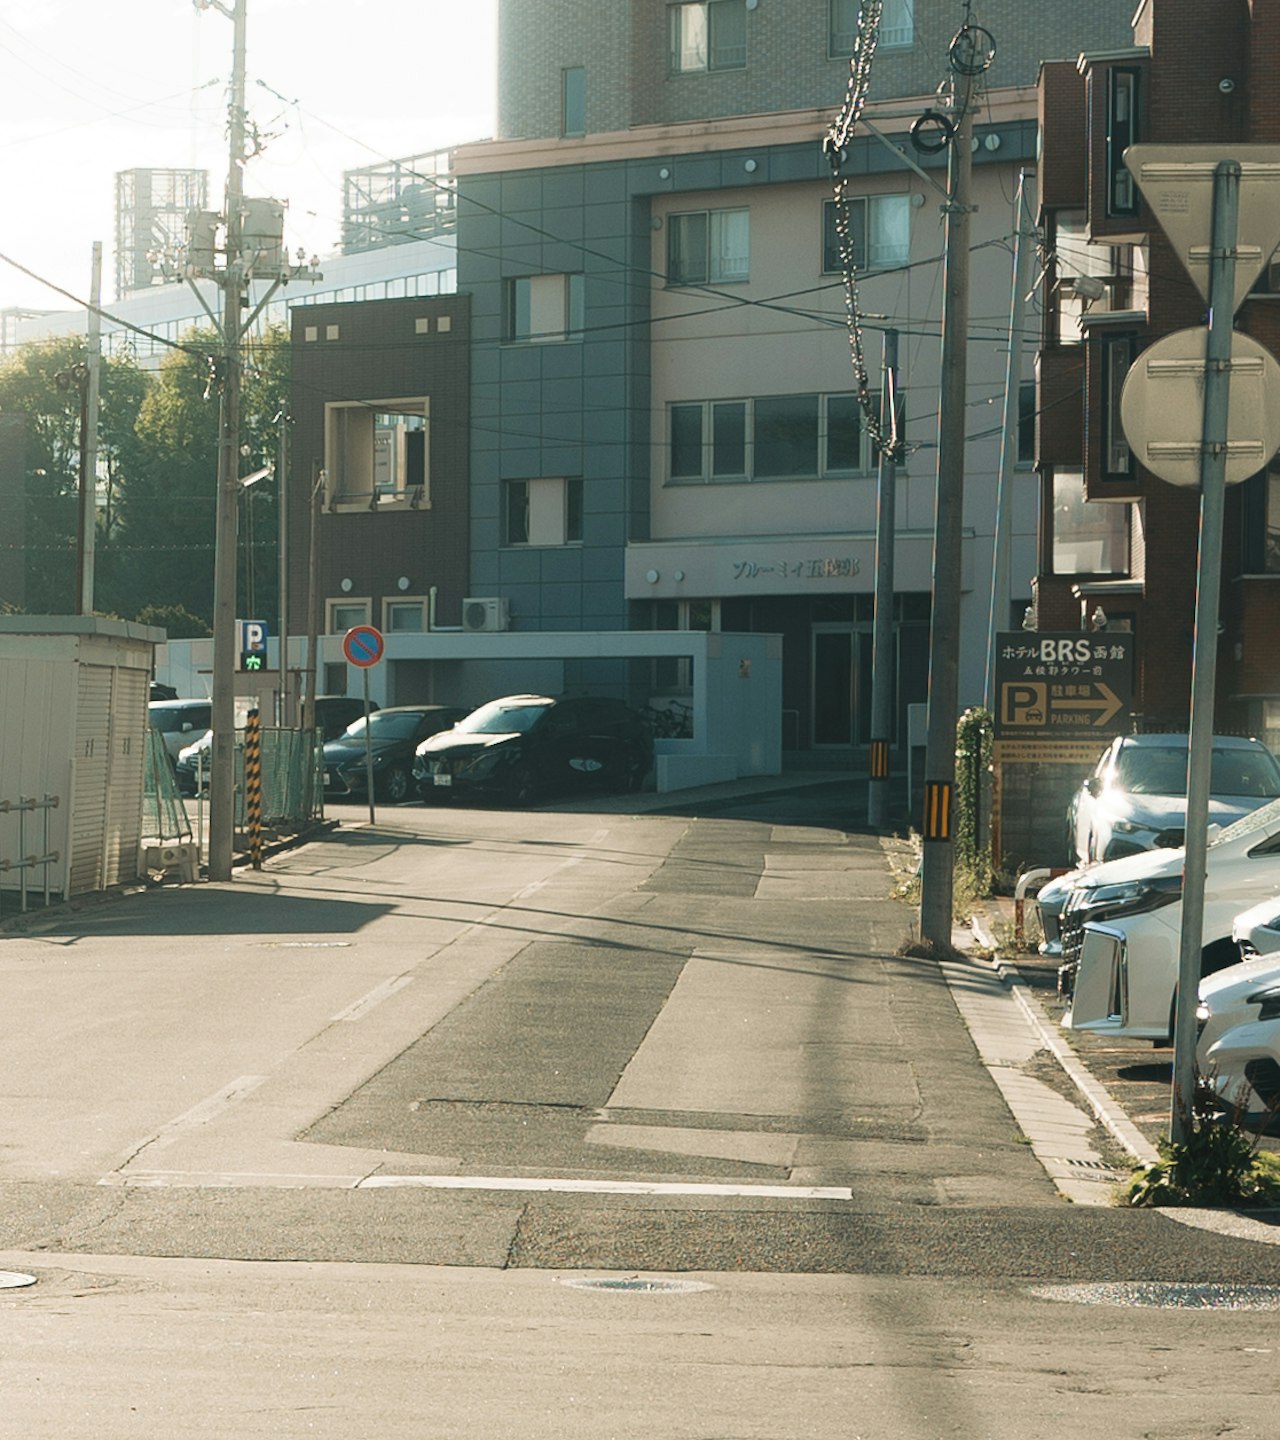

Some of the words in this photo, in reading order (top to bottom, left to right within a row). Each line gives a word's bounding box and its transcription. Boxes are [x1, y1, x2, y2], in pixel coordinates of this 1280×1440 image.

[247, 624, 263, 650] P
[1051, 685, 1091, 697] 駐車場
[1051, 713, 1091, 725] PARKING
